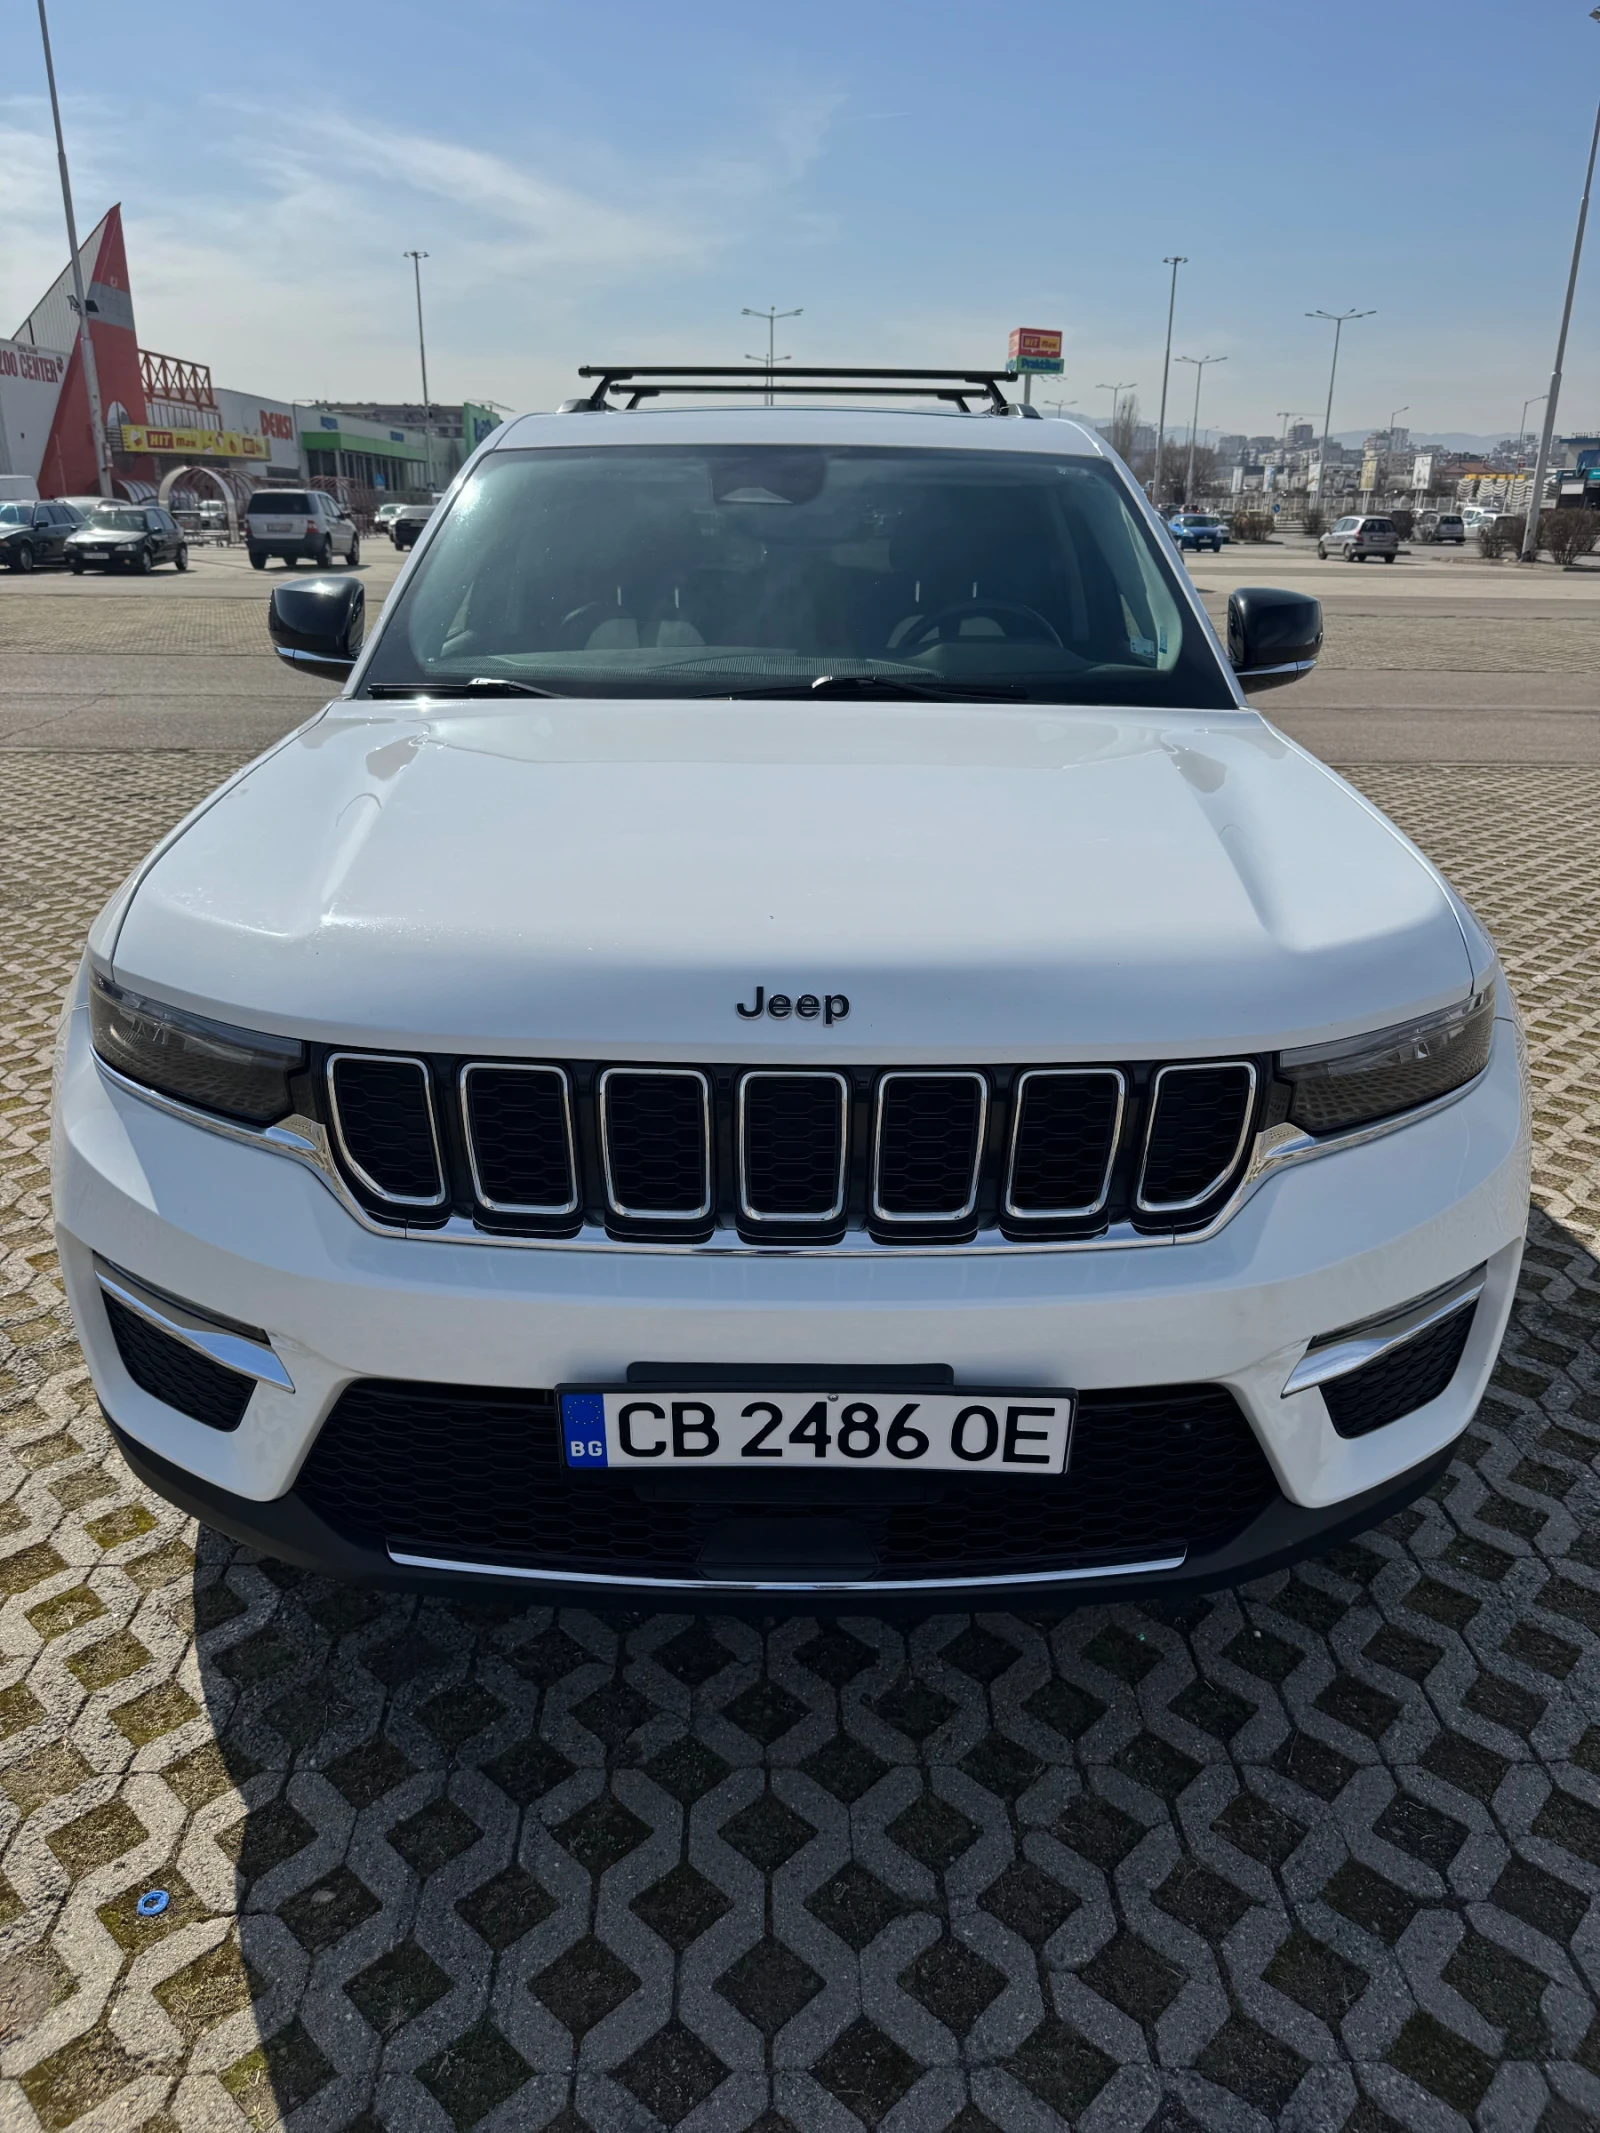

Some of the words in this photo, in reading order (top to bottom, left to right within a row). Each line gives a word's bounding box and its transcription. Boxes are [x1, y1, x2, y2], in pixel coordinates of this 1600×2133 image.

[20, 353, 58, 383] CENTER
[150, 433, 171, 447] HIT
[735, 985, 850, 1028] Jeep
[618, 1401, 720, 1458] CB
[740, 1401, 930, 1460] 2486
[570, 1440, 603, 1457] BG
